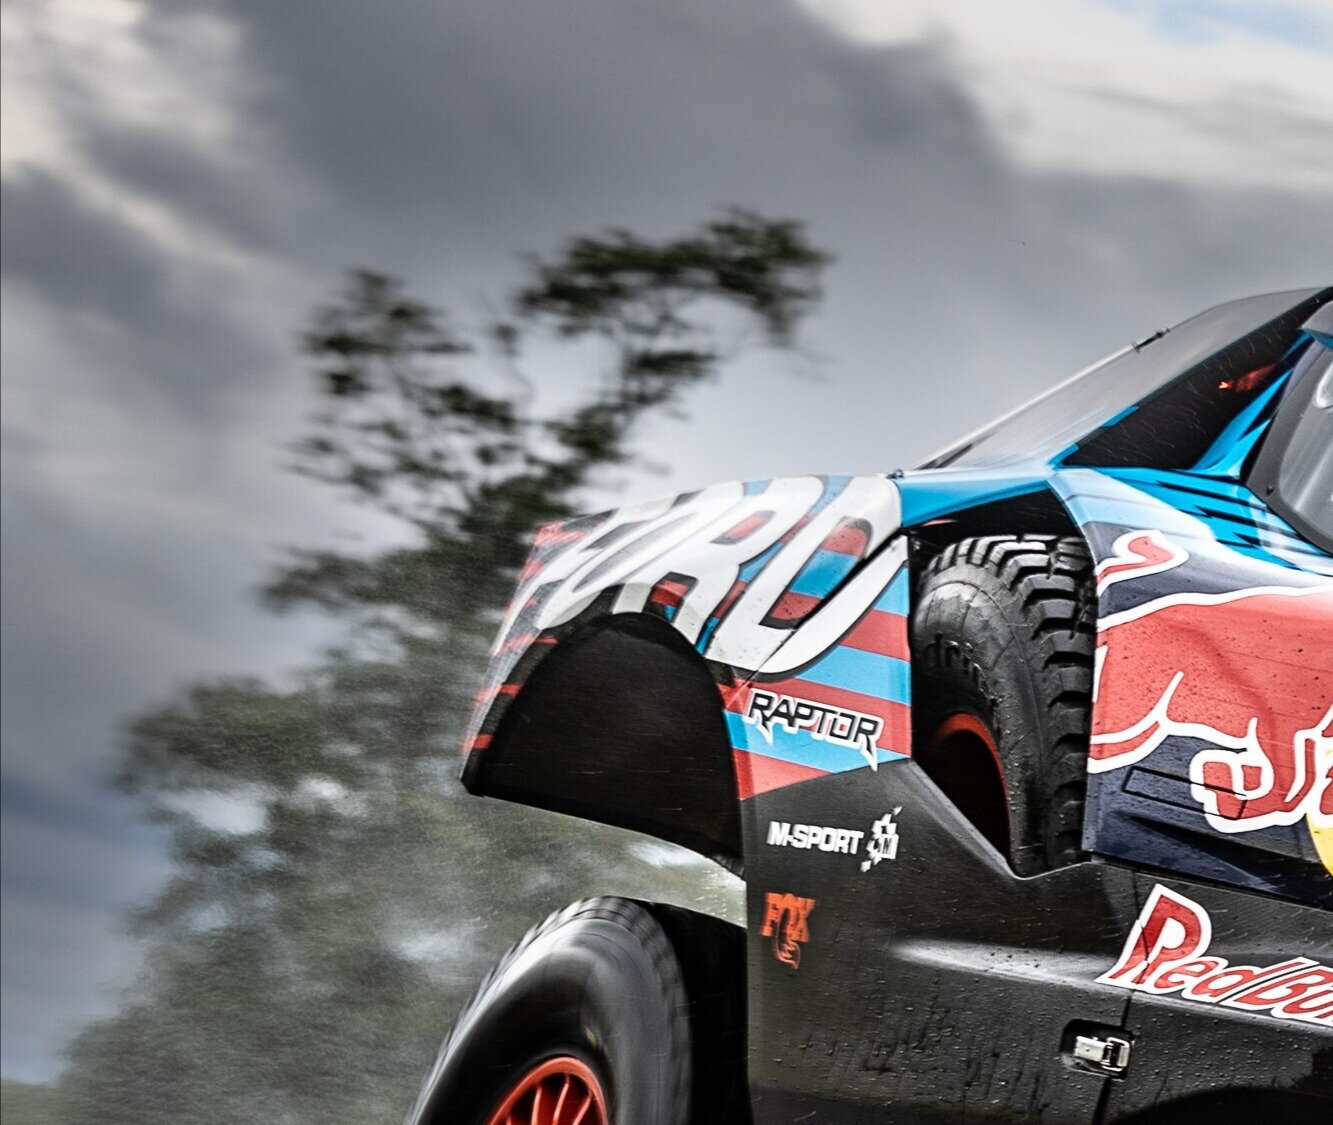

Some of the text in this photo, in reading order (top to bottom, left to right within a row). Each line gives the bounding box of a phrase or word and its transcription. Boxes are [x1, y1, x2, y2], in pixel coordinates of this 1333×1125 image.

[492, 475, 907, 674] FORD
[745, 689, 883, 771] RAPTOR
[766, 820, 865, 855] M-SPORT
[760, 892, 815, 968] FOX
